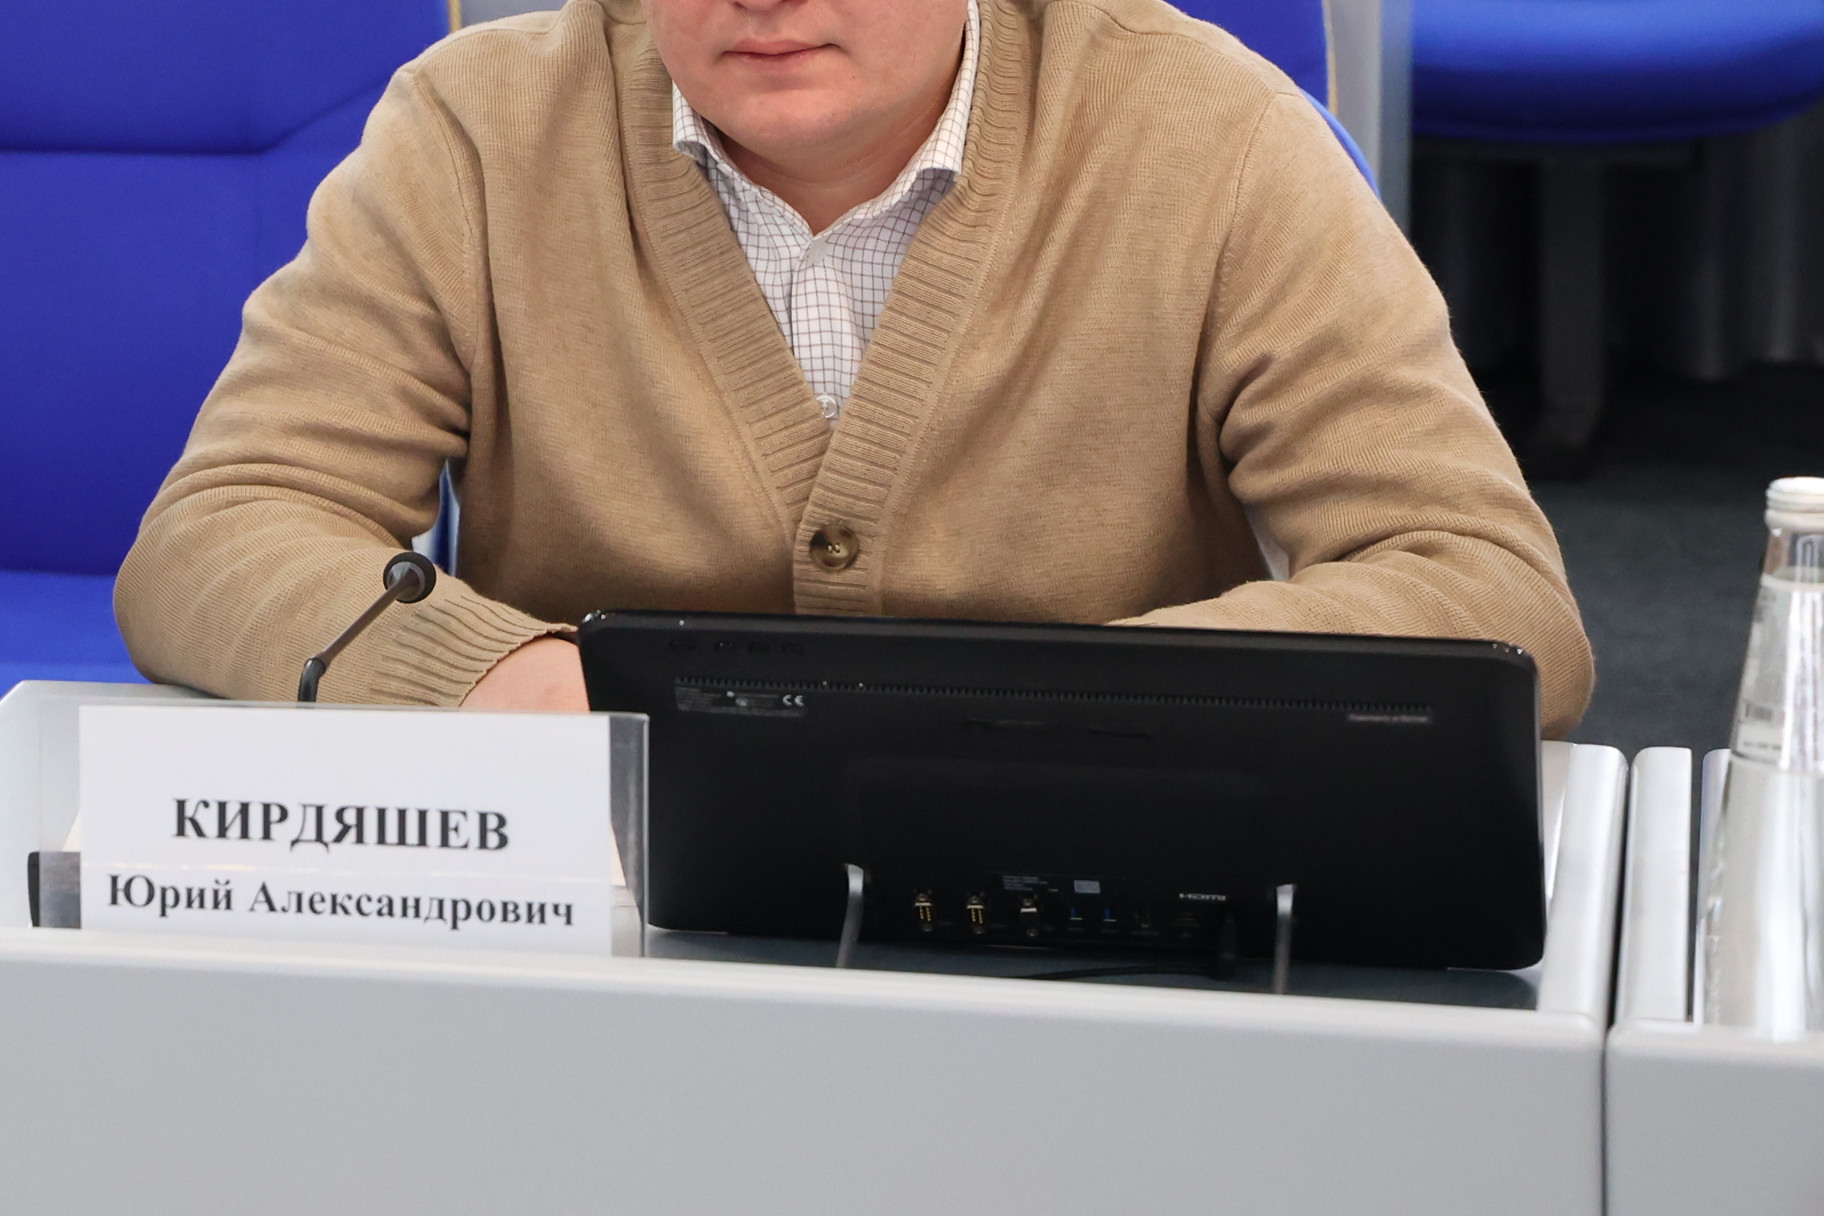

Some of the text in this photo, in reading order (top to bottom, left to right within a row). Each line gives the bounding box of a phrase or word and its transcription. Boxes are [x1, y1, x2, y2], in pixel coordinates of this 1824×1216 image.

[173, 798, 510, 852] КИРДЯШЕВ
[108, 874, 574, 931] Юрий Александрович
